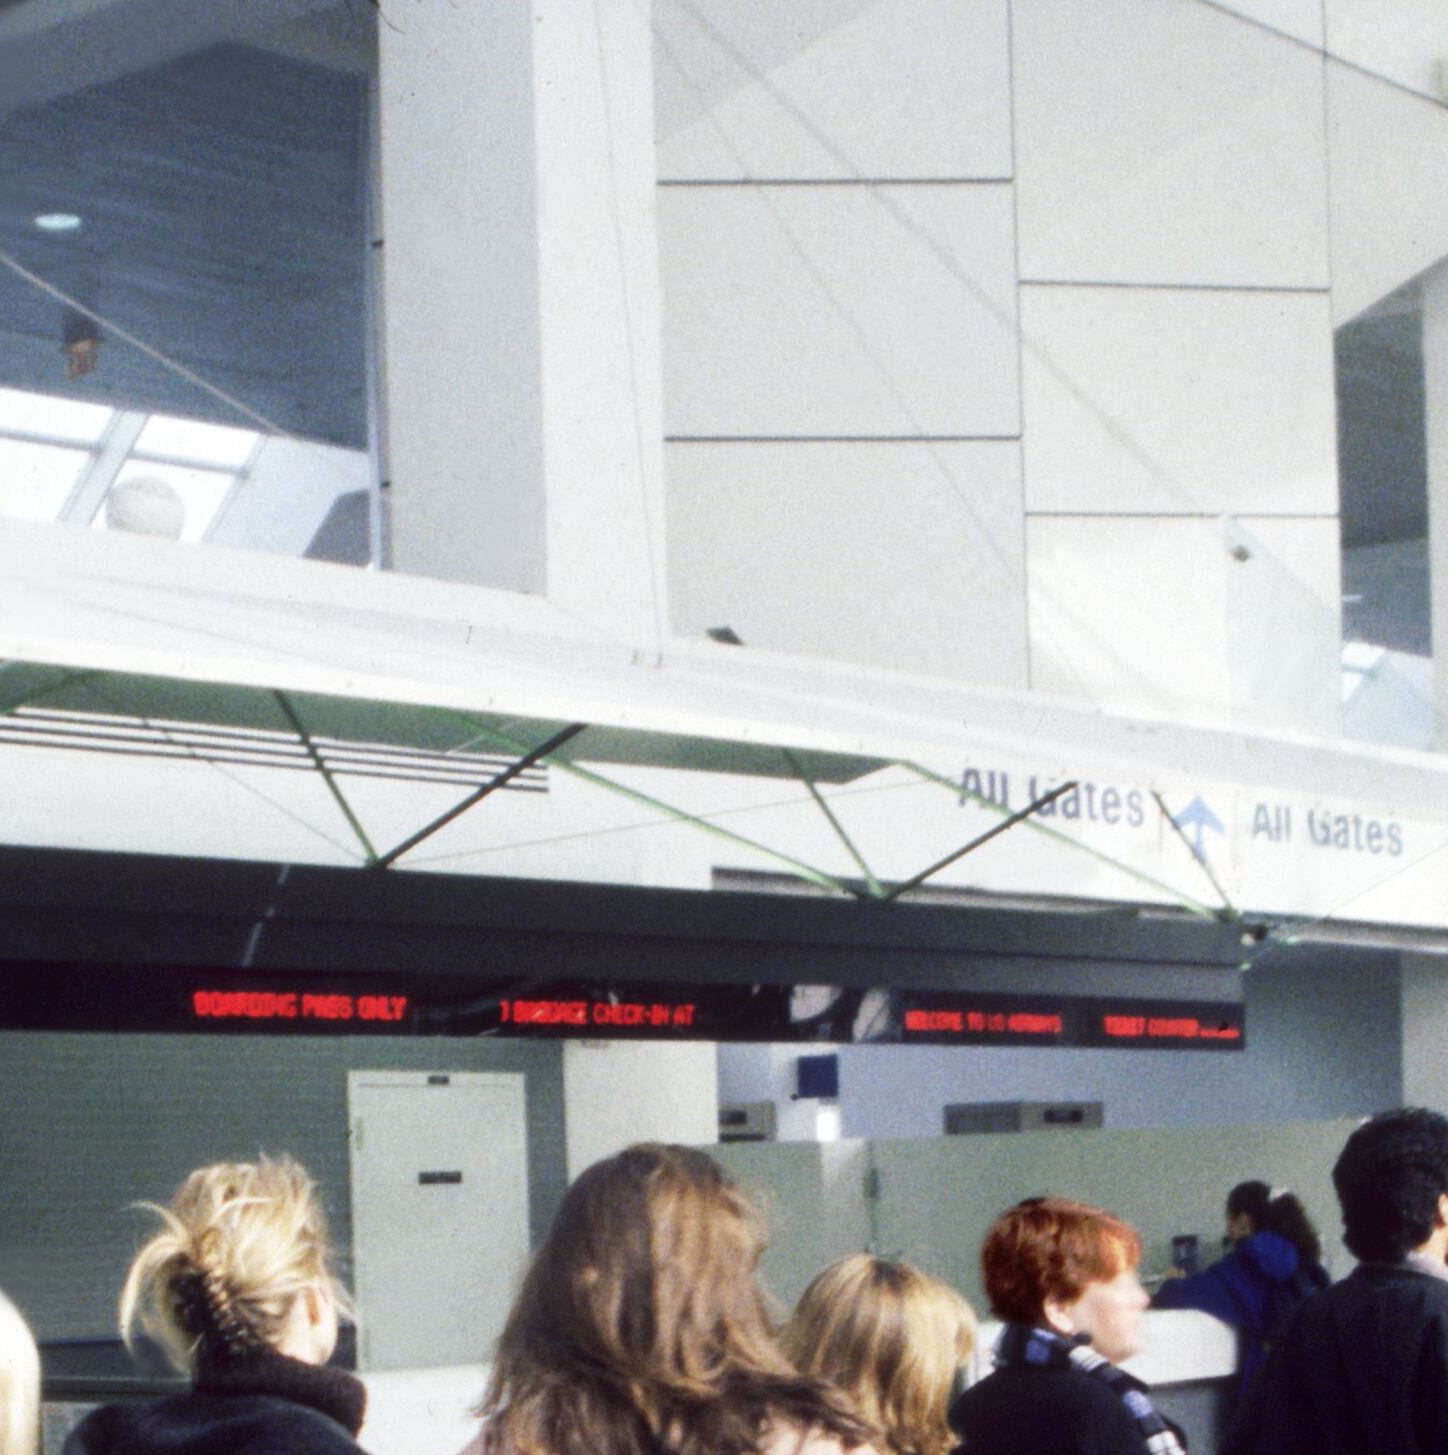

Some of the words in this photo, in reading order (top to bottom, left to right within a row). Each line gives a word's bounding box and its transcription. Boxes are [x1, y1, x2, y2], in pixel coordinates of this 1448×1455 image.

[957, 767, 1009, 809] All
[1253, 802, 1291, 842] All
[1307, 808, 1402, 857] Gates
